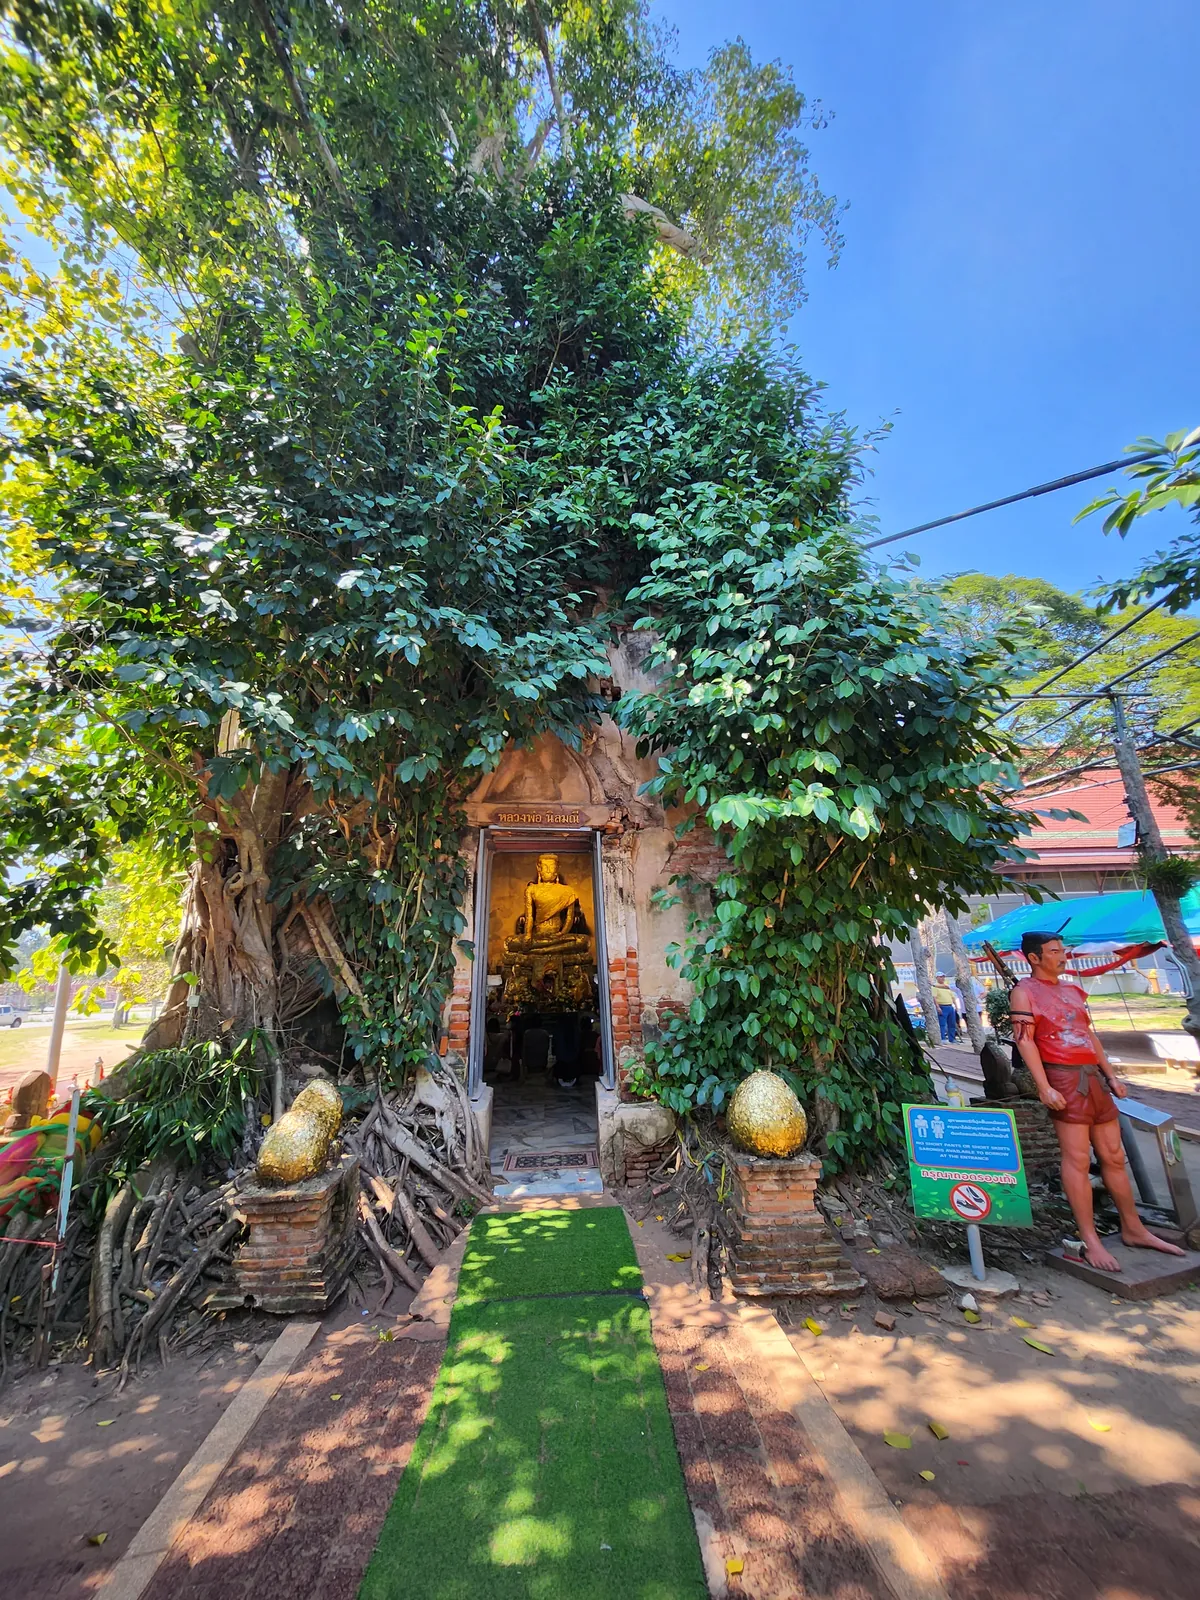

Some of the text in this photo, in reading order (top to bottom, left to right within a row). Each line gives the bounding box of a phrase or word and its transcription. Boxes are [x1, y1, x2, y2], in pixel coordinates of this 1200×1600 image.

[498, 810, 579, 823] หลวงพ่อ นิลมณี
[921, 1169, 1018, 1185] กรุณาถอดรองเท้า
